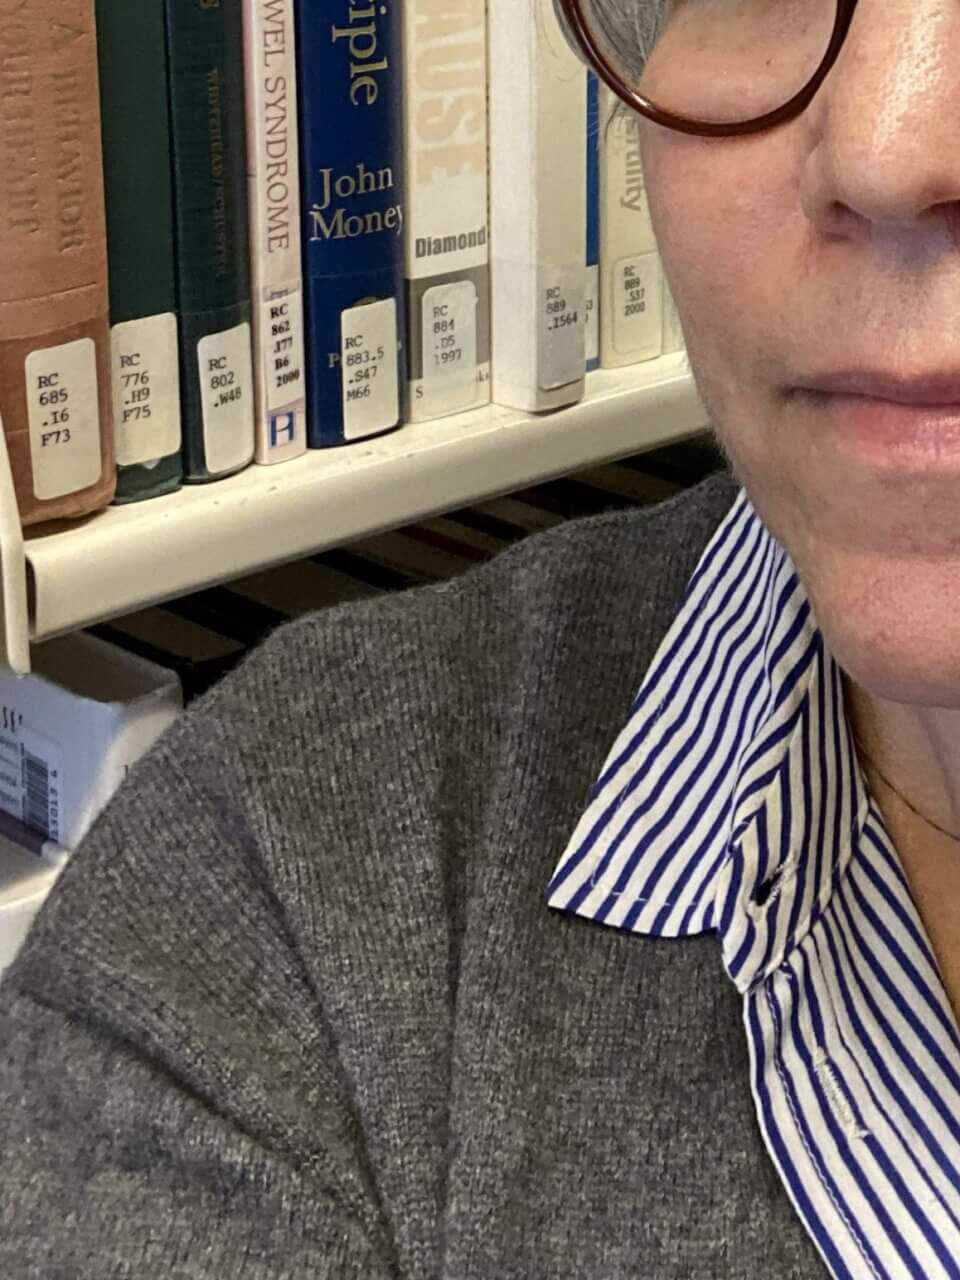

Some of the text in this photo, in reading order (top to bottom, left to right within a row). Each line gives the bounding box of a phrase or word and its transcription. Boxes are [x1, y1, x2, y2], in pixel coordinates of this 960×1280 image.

[264, 75, 290, 254] SYNDROME
[314, 164, 393, 210] John
[309, 202, 403, 242] Money
[414, 224, 488, 259] Diamond
[624, 265, 636, 278] RC
[546, 286, 561, 300] RC
[270, 303, 289, 320] RC
[433, 305, 449, 319] RC
[546, 299, 566, 315] 889
[624, 301, 646, 316] 2000
[271, 321, 291, 337] 862
[433, 320, 455, 334] 884
[345, 335, 364, 350] RC
[434, 335, 456, 351] .D5
[119, 353, 142, 369] RC
[208, 356, 228, 372] RC
[274, 357, 290, 371] B6
[346, 346, 385, 367] 883.5
[434, 349, 462, 366] 1997
[37, 373, 60, 389] RC
[122, 371, 150, 387] 776
[210, 372, 236, 389] 802
[276, 369, 301, 388] 2000
[348, 366, 379, 385] .S47
[38, 389, 69, 406] 685
[124, 388, 151, 406] .H9
[213, 387, 243, 408] .W48
[346, 385, 372, 402] M66
[41, 408, 71, 427] .I6
[122, 406, 152, 423] F75
[41, 429, 72, 447] F73
